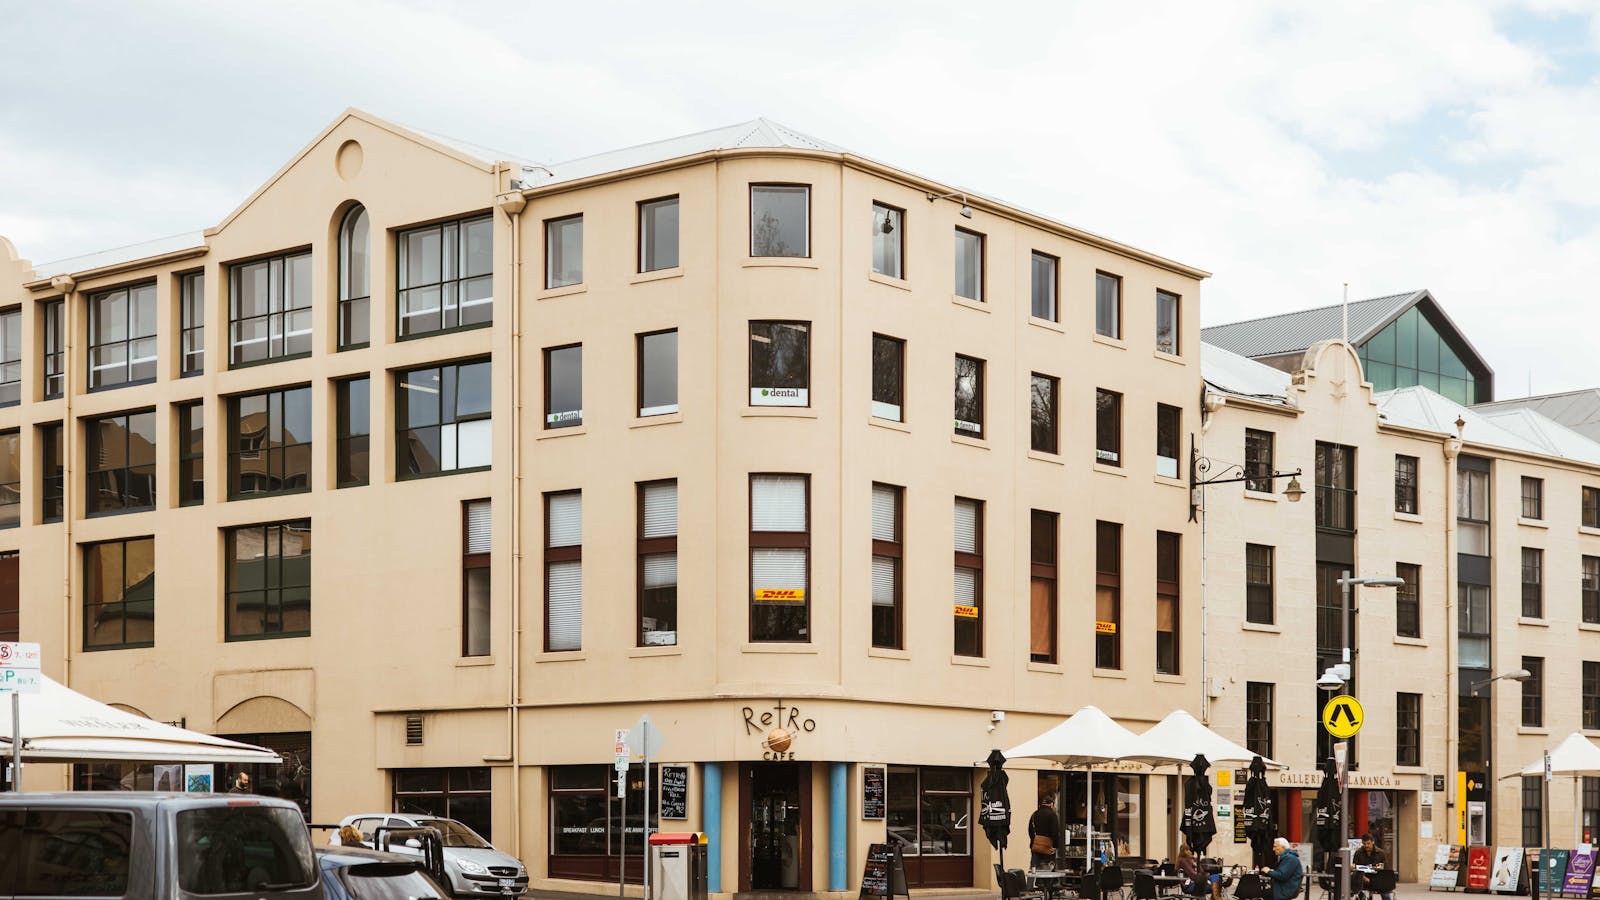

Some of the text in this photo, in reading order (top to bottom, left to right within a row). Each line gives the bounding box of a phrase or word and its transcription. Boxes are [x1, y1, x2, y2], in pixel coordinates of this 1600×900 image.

[770, 387, 799, 397] dental
[560, 410, 580, 421] dental
[762, 590, 797, 599] DHL
[955, 606, 975, 616] DHL
[1096, 623, 1113, 631] DHL
[763, 751, 796, 761] CAFE
[1280, 772, 1321, 785] GALLERI
